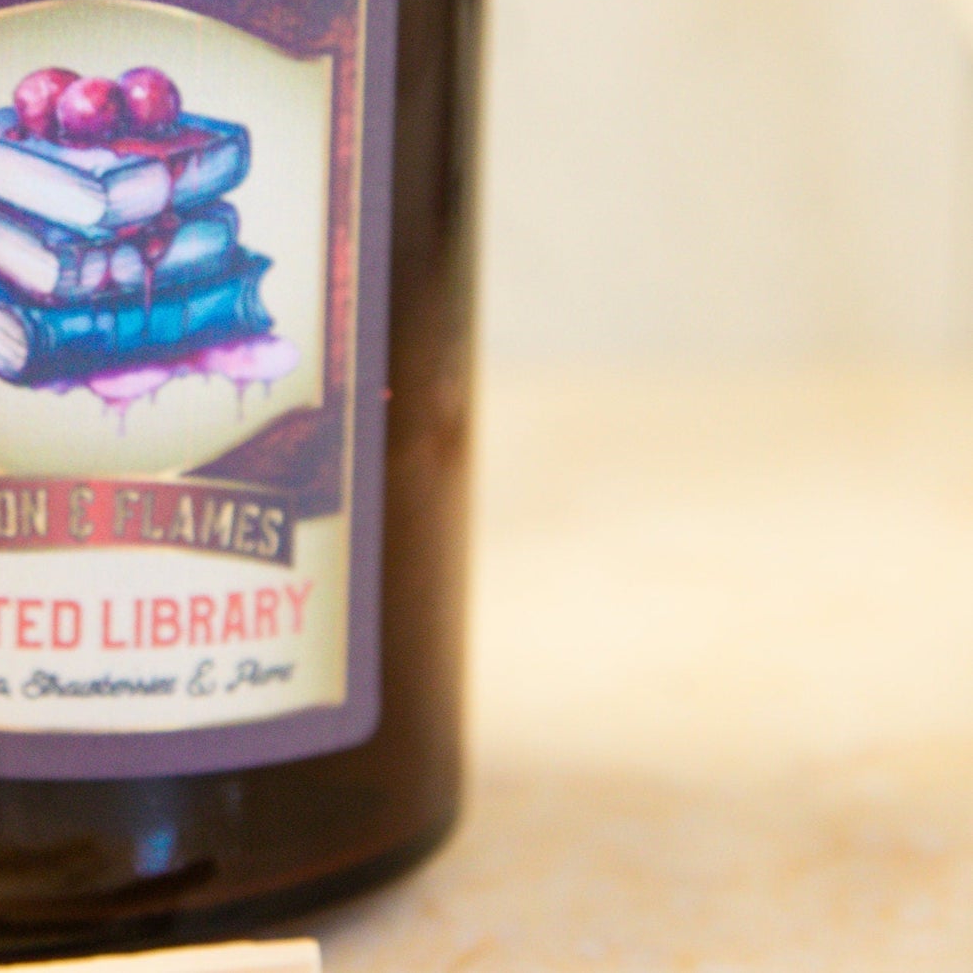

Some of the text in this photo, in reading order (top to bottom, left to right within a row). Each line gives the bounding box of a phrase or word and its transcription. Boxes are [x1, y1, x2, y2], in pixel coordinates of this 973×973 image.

[69, 487, 94, 542] &
[113, 491, 284, 556] FLAMES
[102, 580, 314, 650] LIBRARY
